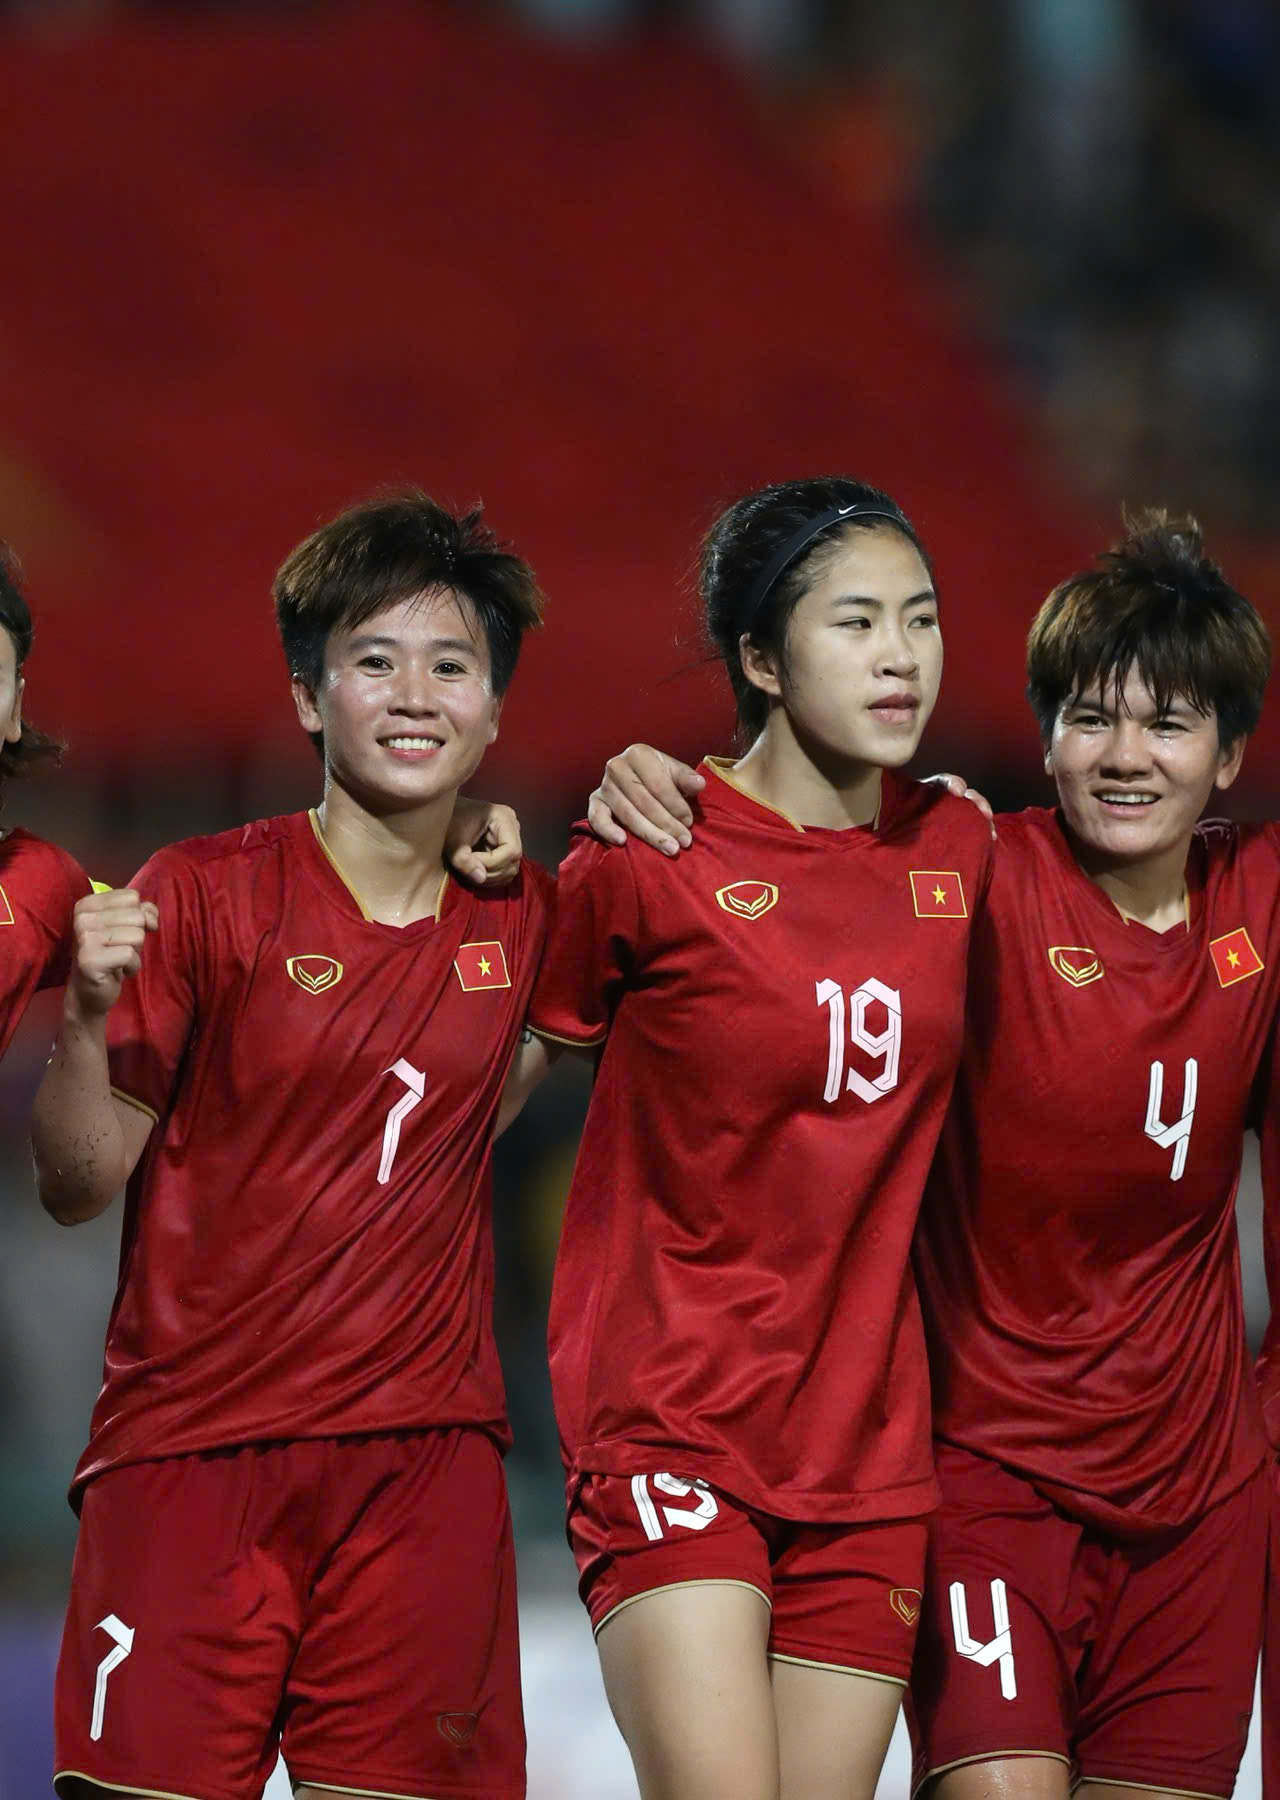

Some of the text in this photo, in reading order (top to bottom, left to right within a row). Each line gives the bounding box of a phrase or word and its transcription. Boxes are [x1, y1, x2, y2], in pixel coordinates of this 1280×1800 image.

[815, 976, 902, 1104] 19
[375, 1057, 426, 1185] 7
[1143, 1057, 1198, 1182] 4
[89, 1613, 136, 1742] 7
[949, 1577, 1018, 1701] 4
